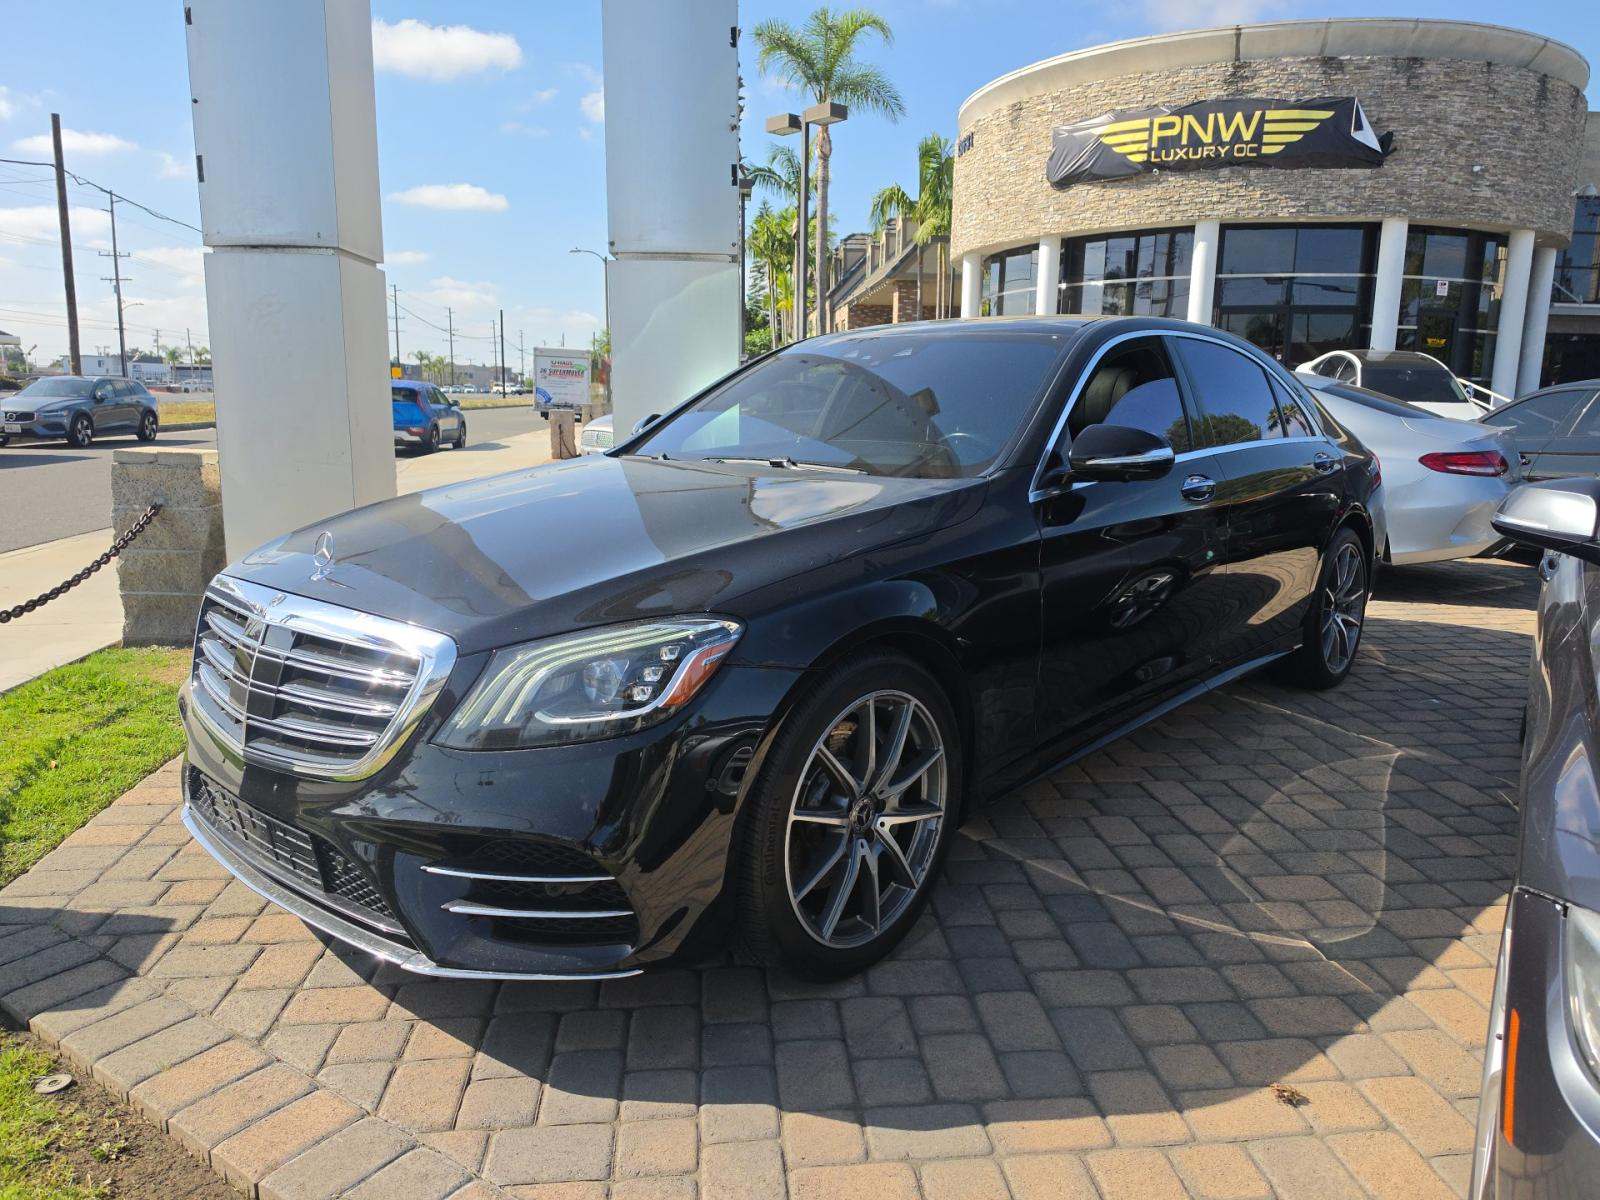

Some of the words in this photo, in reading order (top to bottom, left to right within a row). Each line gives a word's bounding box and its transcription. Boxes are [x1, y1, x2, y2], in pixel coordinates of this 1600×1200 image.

[1151, 110, 1263, 148] PNW
[1151, 145, 1230, 161] LUXURY
[1233, 143, 1258, 157] OC
